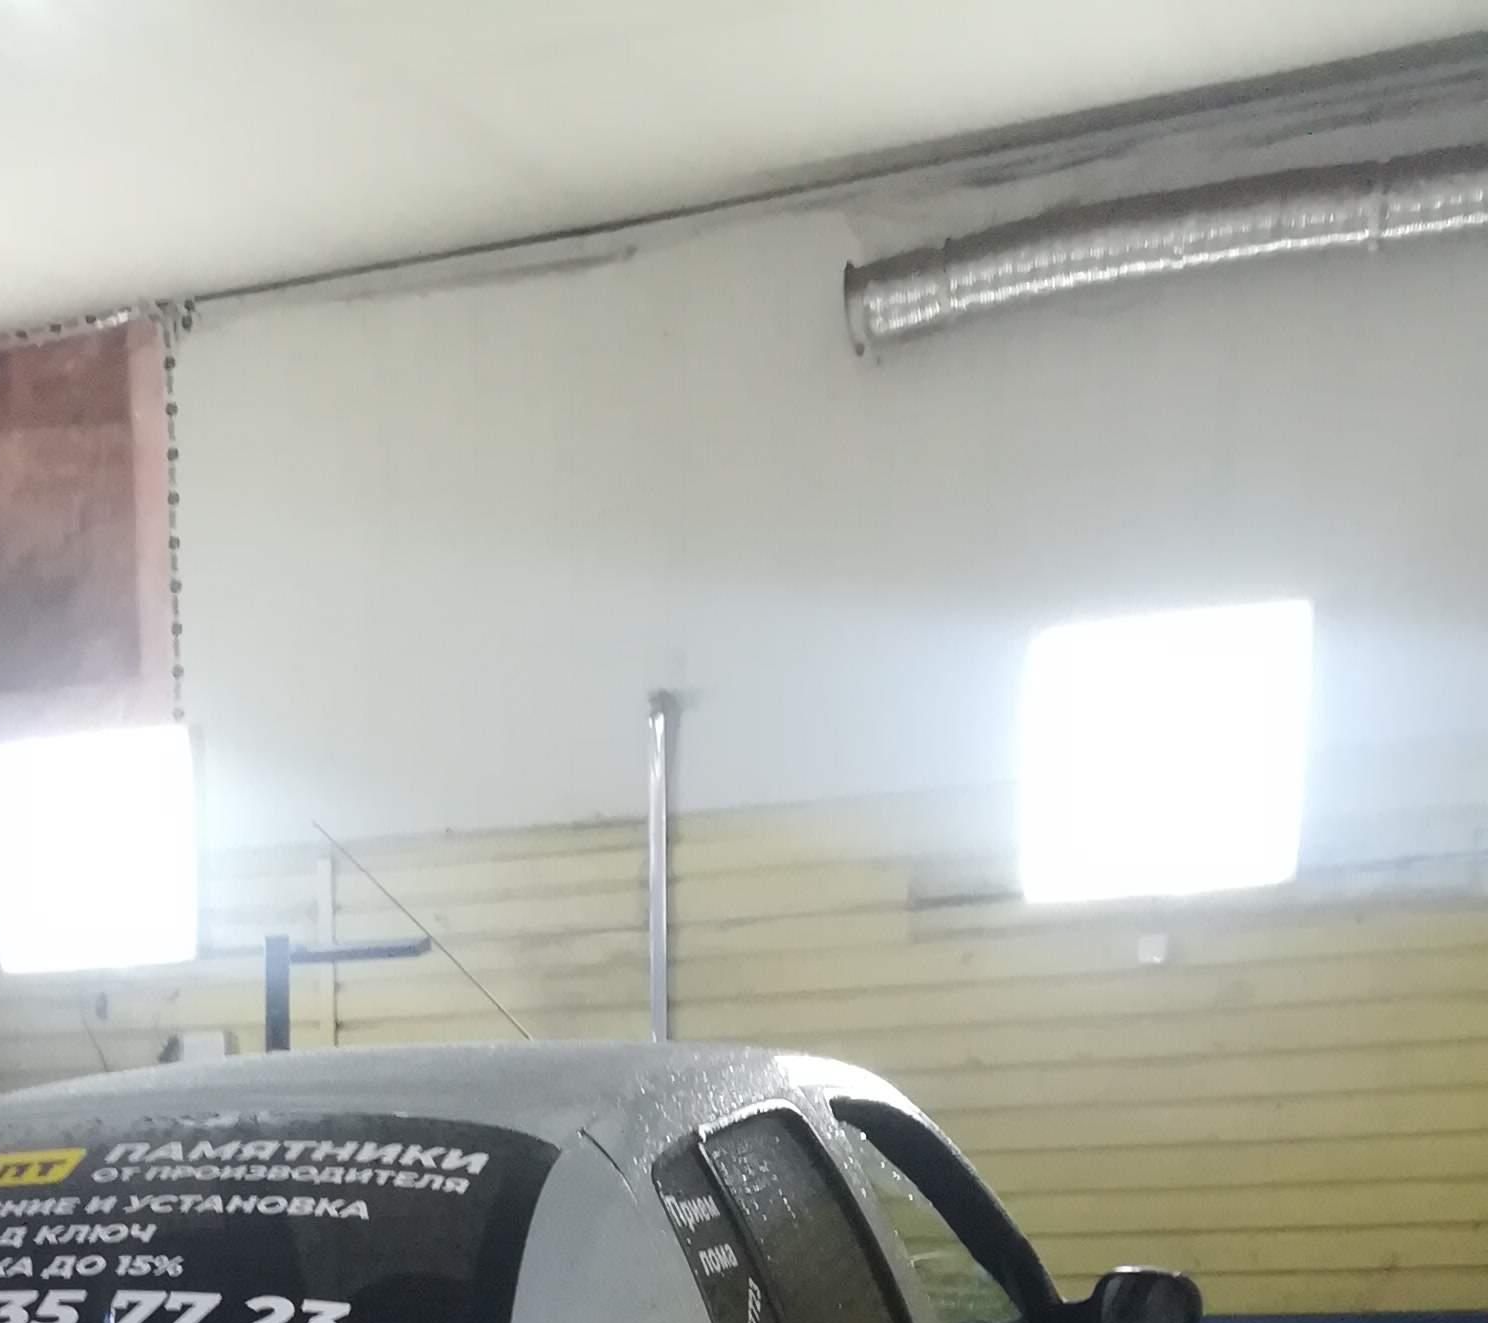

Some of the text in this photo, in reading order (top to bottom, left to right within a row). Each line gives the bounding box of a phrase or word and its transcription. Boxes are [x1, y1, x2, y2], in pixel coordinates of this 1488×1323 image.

[105, 1140, 489, 1175] ПАМЯТНИКИ
[91, 1164, 471, 1195] ОТ ПРОИЗВОДИТЕЛЯ
[85, 1195, 118, 1215] И
[122, 1194, 369, 1221] УСТАНОВКА
[33, 1223, 157, 1247] КЛЮЧ
[40, 1254, 107, 1280] ДО
[114, 1254, 185, 1278] 15%
